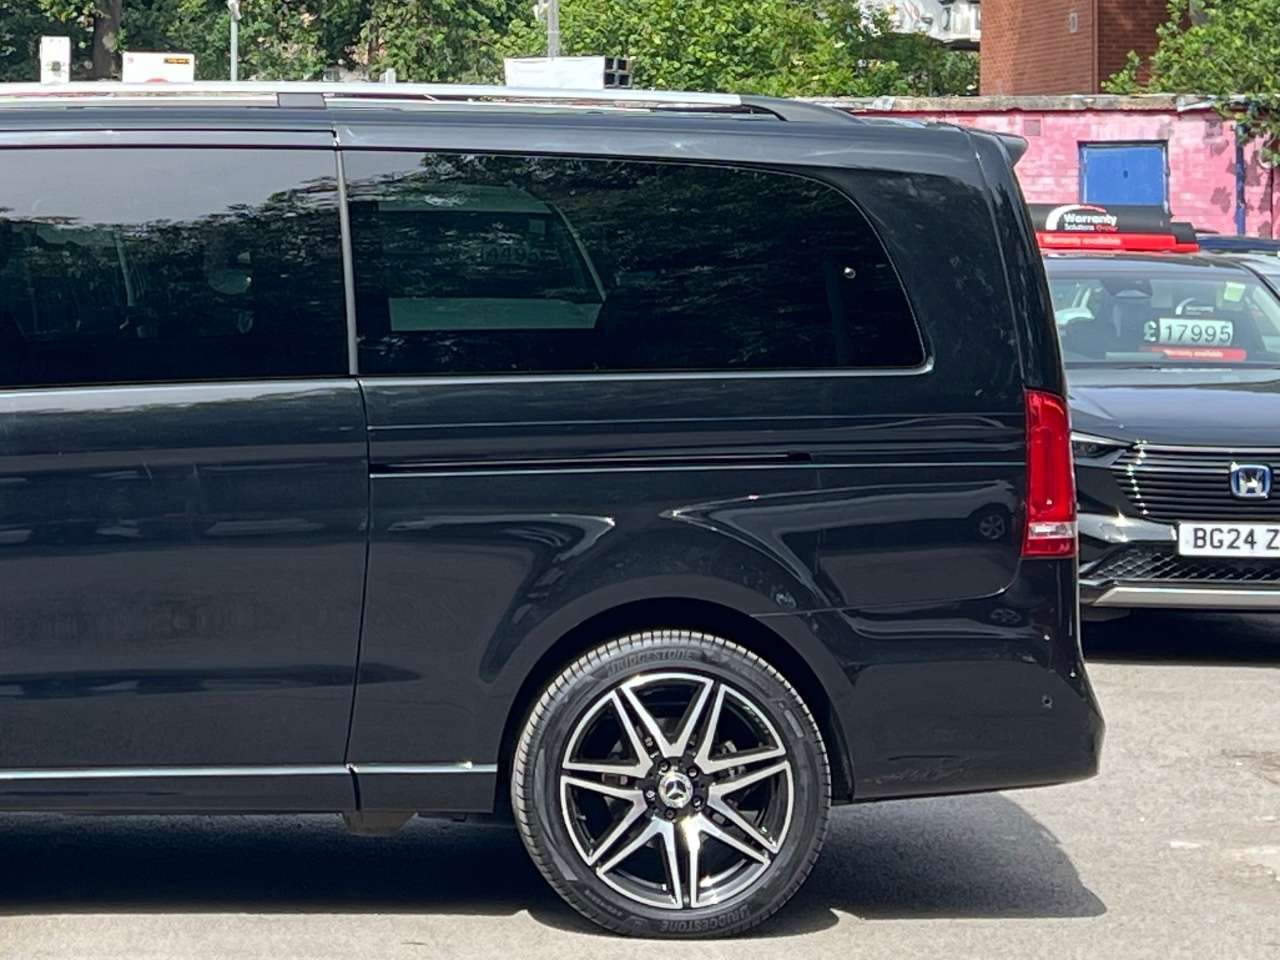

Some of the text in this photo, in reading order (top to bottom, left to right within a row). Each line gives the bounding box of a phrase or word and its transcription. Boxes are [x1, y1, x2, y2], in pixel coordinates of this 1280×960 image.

[1064, 214, 1117, 226] Warranty
[1193, 527, 1280, 550] BG24 Z
